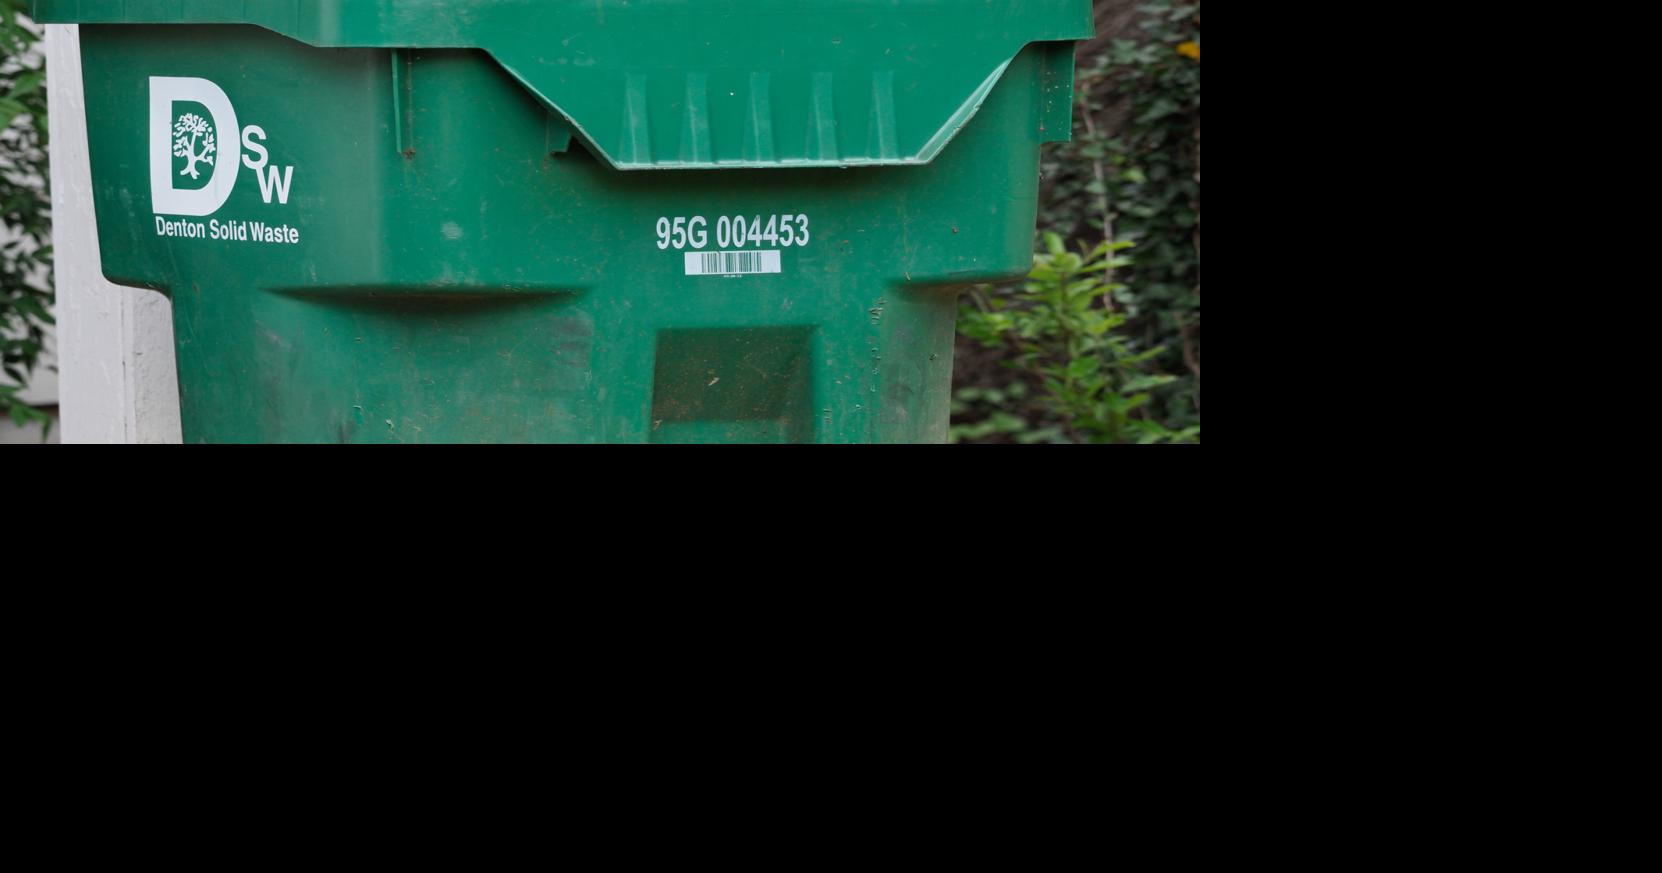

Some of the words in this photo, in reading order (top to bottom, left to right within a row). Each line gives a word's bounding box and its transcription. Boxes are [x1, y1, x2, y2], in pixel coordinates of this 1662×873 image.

[155, 215, 206, 239] Denton
[209, 218, 248, 241] Solid
[249, 221, 299, 244] Waste
[656, 215, 708, 250] 95G
[716, 213, 810, 248] 004453
